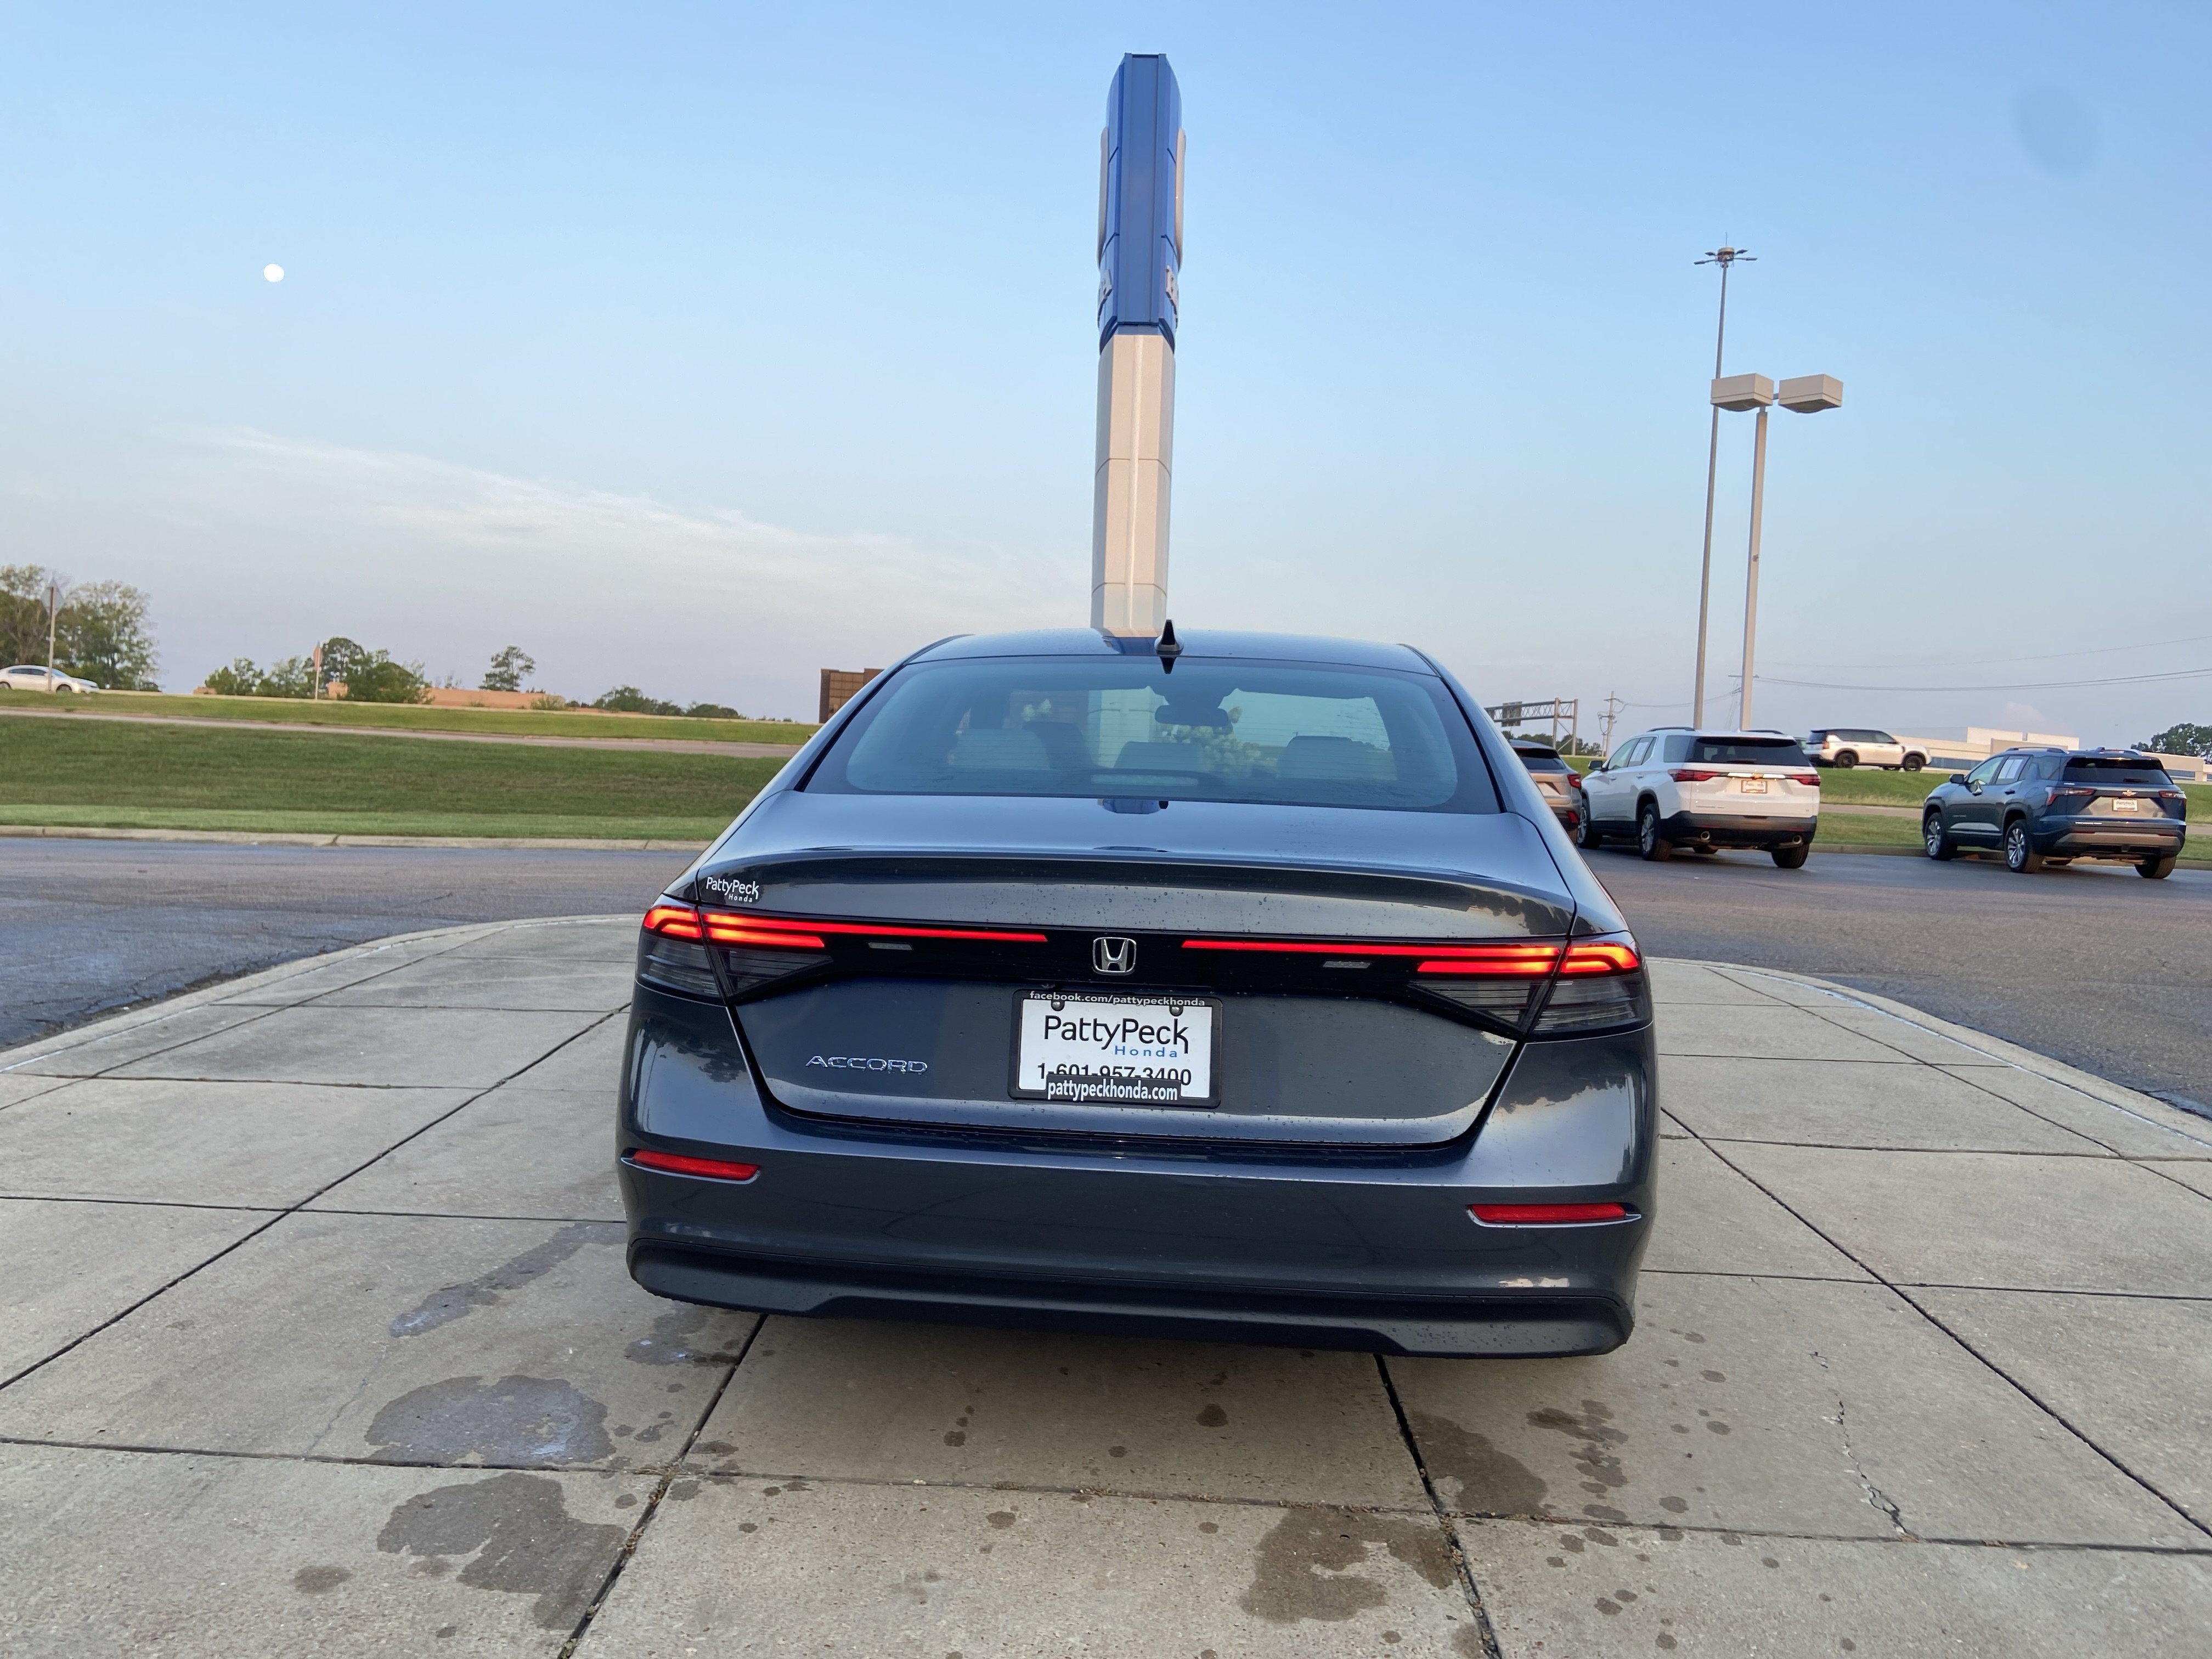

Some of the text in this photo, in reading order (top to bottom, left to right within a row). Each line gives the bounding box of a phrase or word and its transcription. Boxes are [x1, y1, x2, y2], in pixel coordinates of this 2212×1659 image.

[706, 877, 760, 900] PattyPeck
[728, 894, 753, 902] Honda
[1029, 991, 1205, 1006] facebook.com/pattypeckhonda
[1044, 1015, 1189, 1054] PattyPeck
[1114, 1045, 1178, 1058] Honda
[805, 1056, 928, 1073] ACCORD
[1047, 1078, 1178, 1102] pattypeckhonda.com
